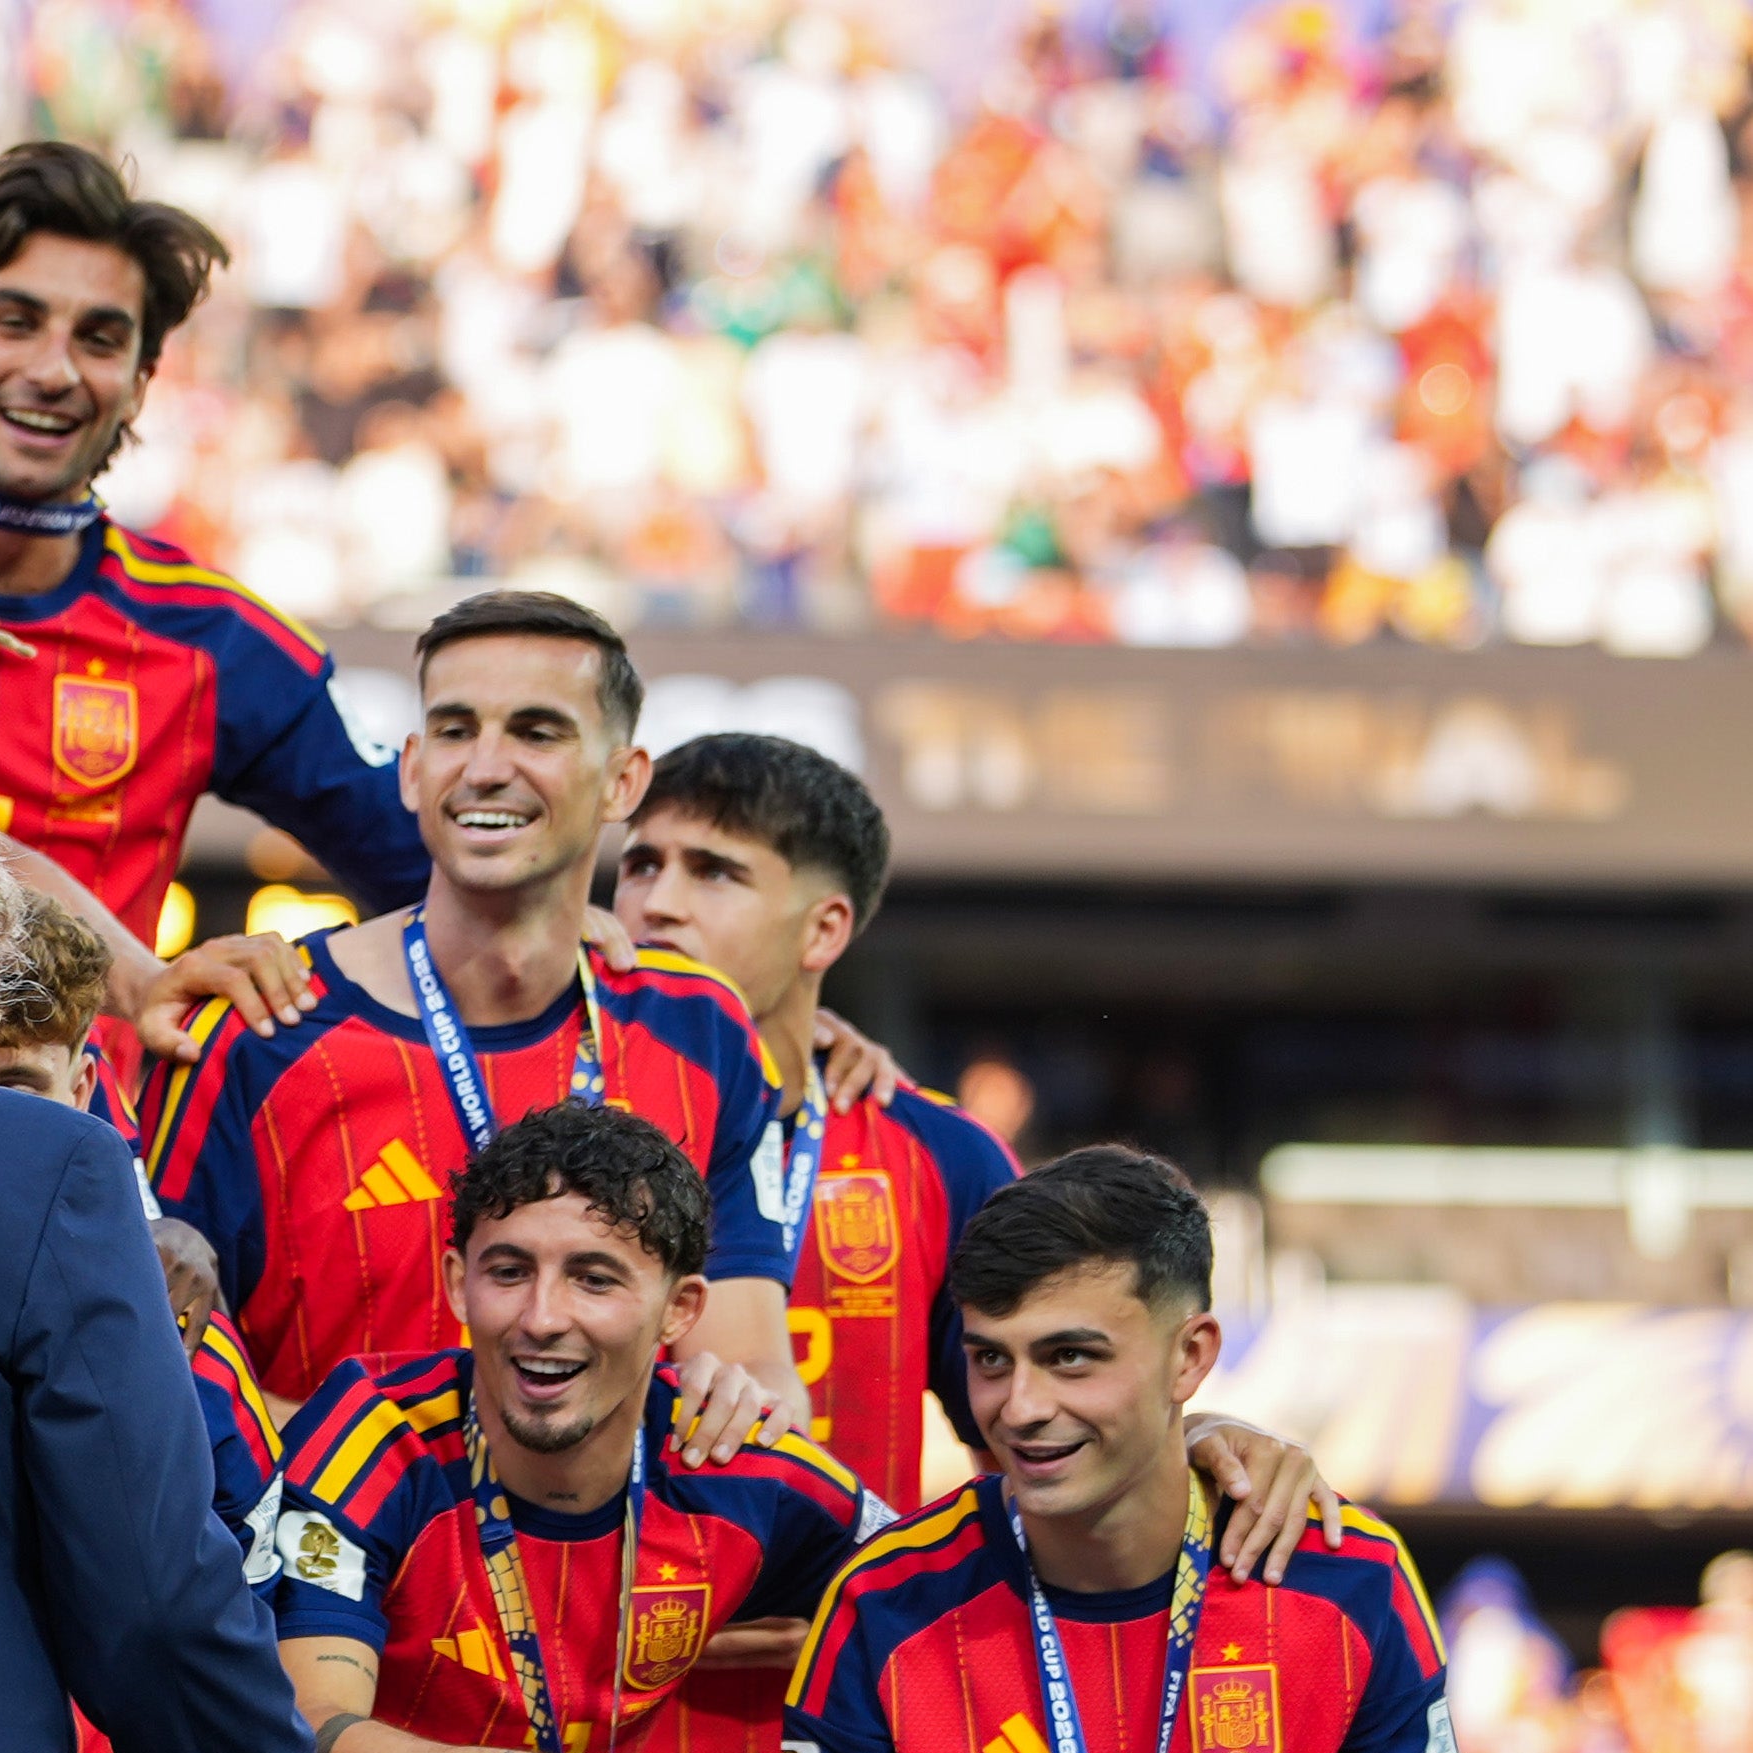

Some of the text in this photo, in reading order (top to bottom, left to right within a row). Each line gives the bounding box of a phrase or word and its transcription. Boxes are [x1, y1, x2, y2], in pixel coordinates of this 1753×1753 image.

[409, 938, 447, 1013] 2026
[432, 1010, 462, 1053] CUP
[448, 1052, 488, 1131] WORLD
[1040, 1633, 1062, 1677] CUP
[1160, 1670, 1183, 1719] FIFA
